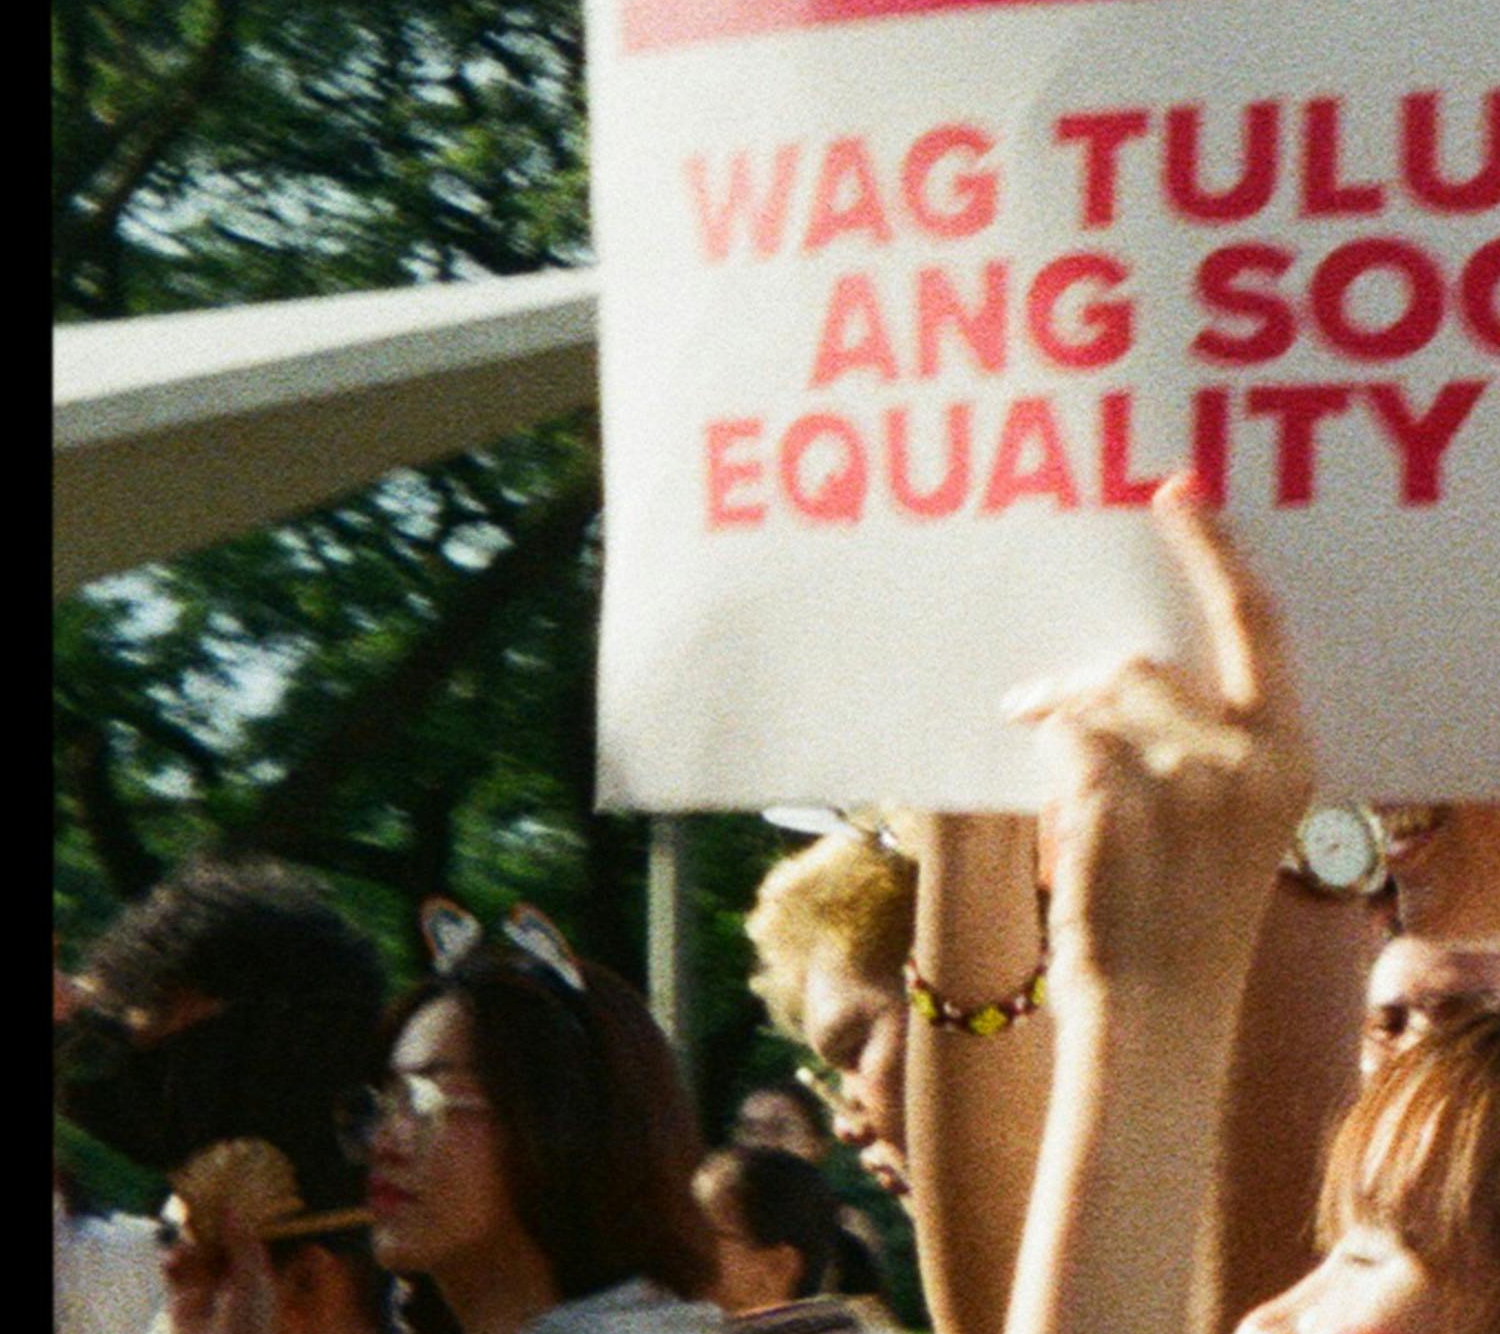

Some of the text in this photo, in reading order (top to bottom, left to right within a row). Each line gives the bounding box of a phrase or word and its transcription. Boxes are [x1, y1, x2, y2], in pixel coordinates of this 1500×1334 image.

[684, 121, 1002, 264] WAG
[808, 249, 1138, 390] ANG
[702, 377, 1492, 531] EQUALITY
